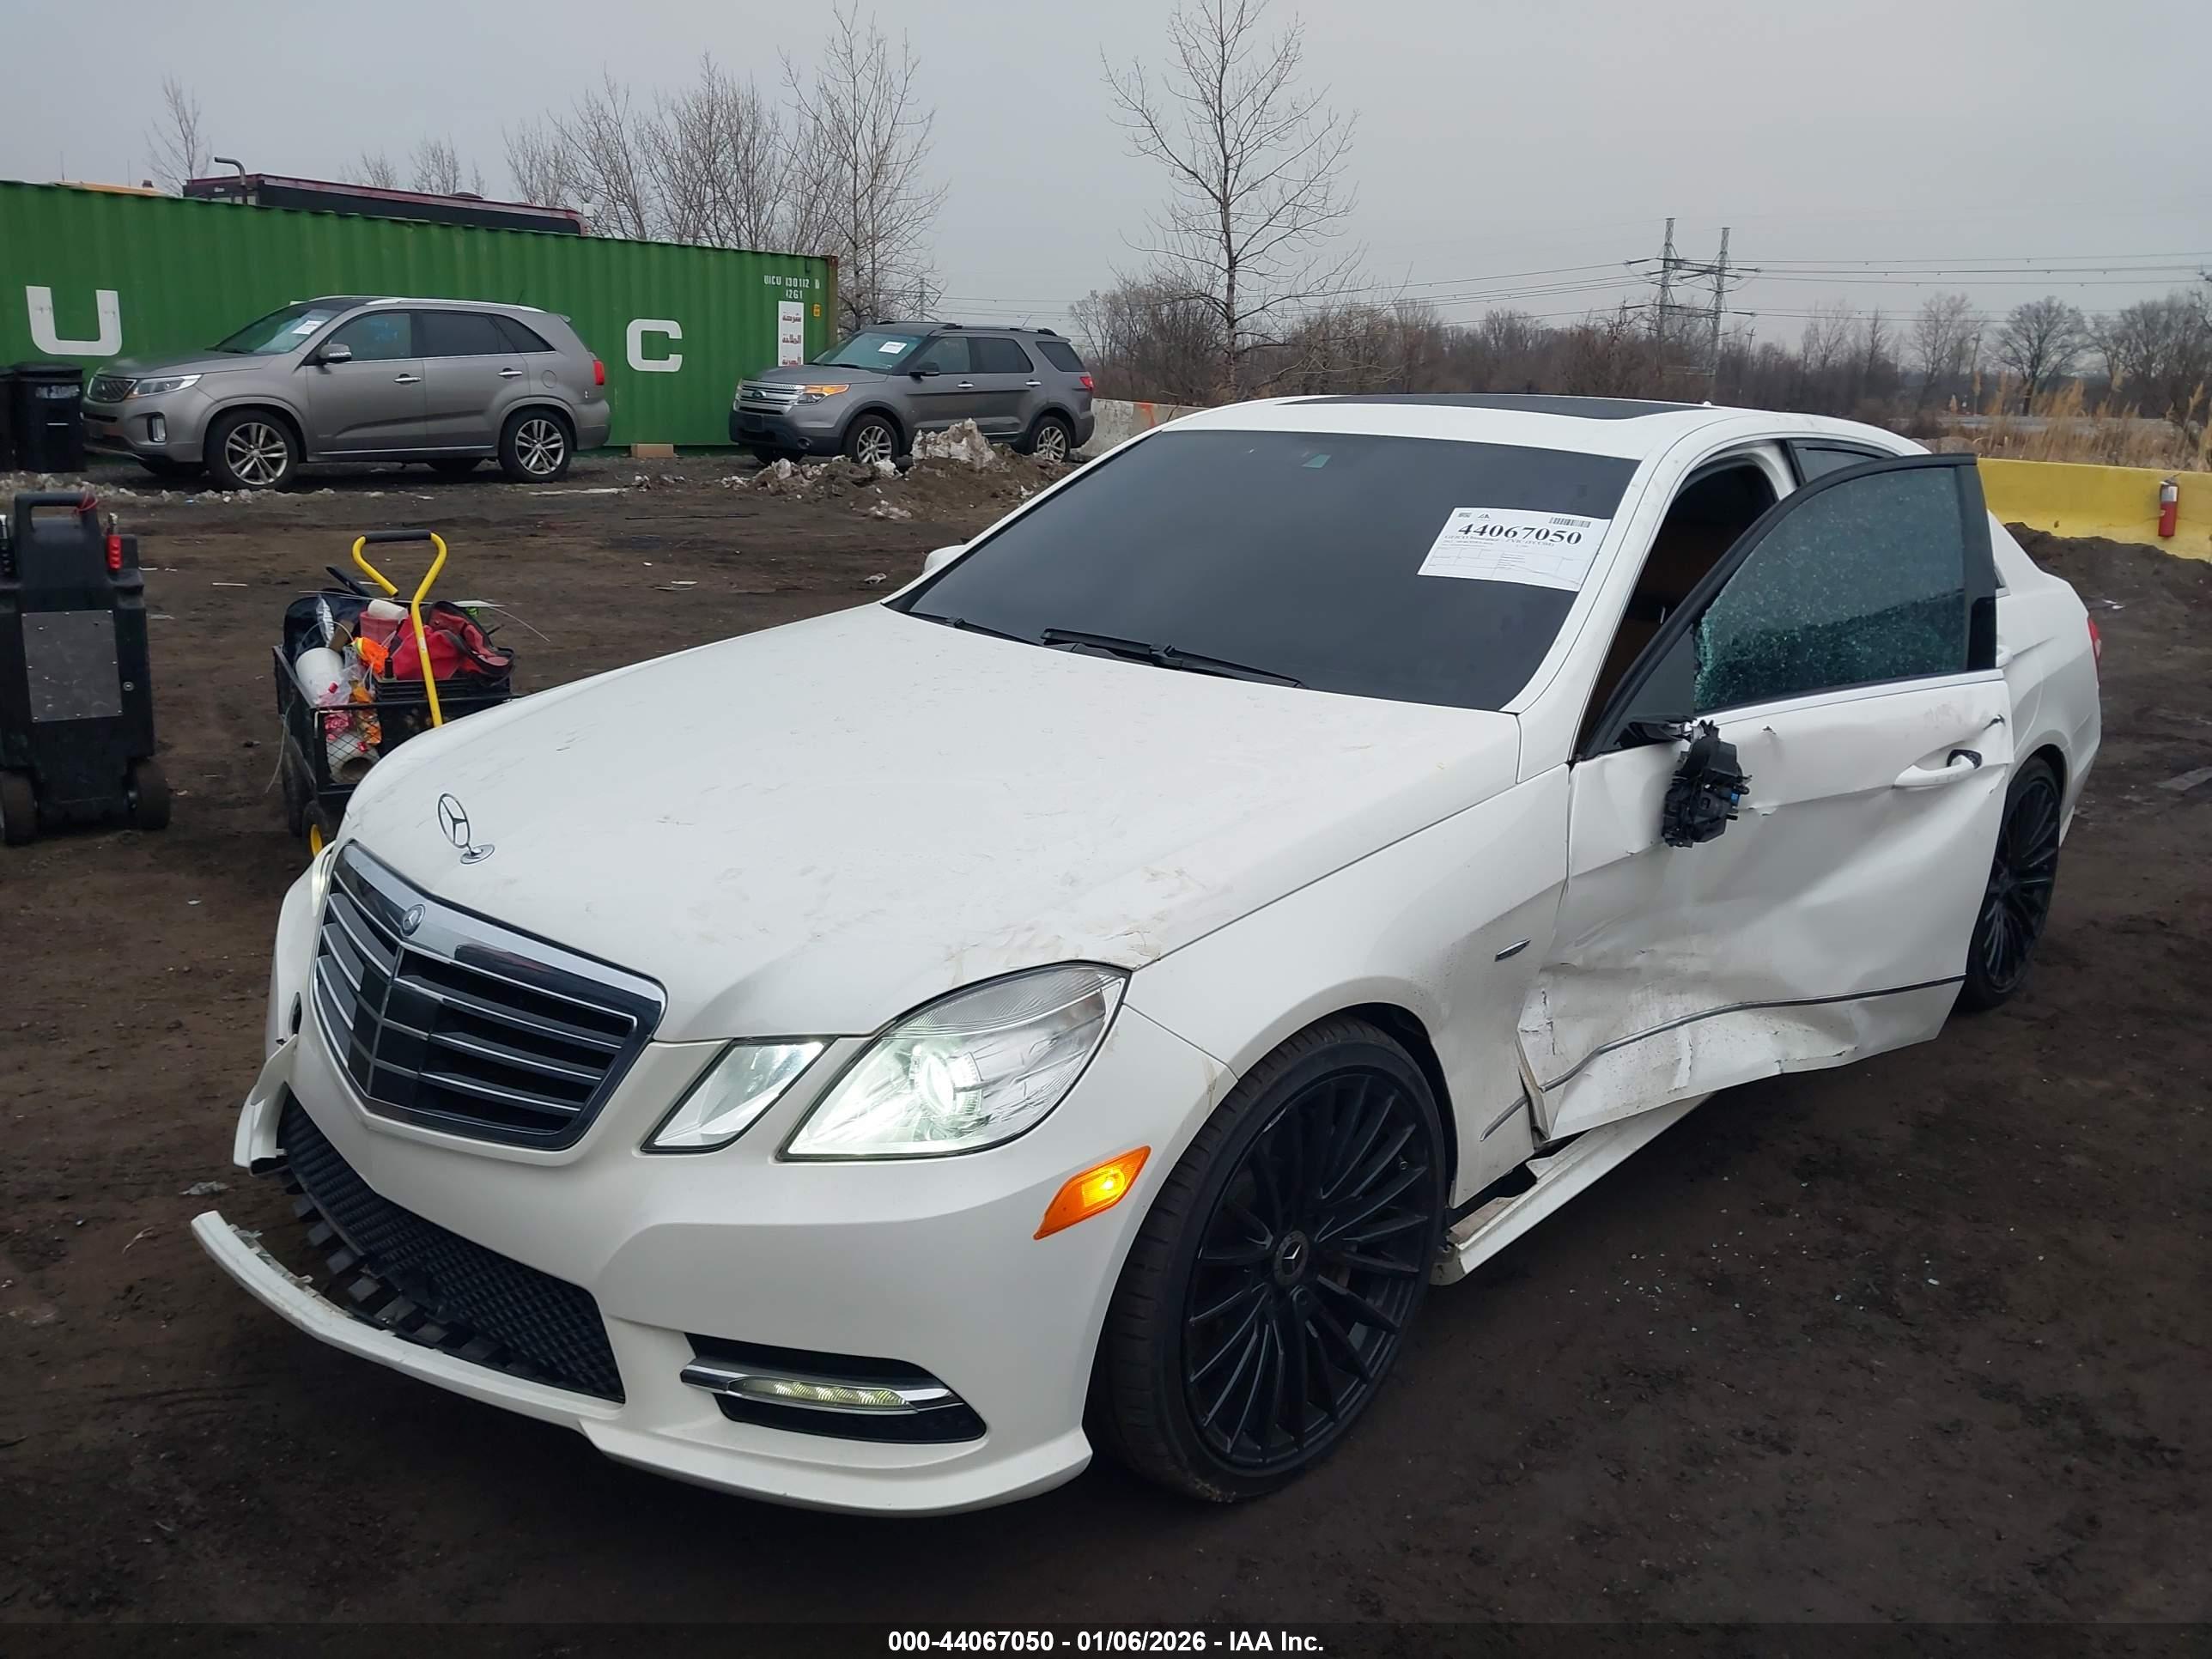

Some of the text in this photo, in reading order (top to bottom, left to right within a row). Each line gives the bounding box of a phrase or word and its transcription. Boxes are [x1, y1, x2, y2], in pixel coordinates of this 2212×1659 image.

[26, 285, 122, 356] U
[626, 319, 683, 373] C
[1458, 523, 1583, 544] 44067050
